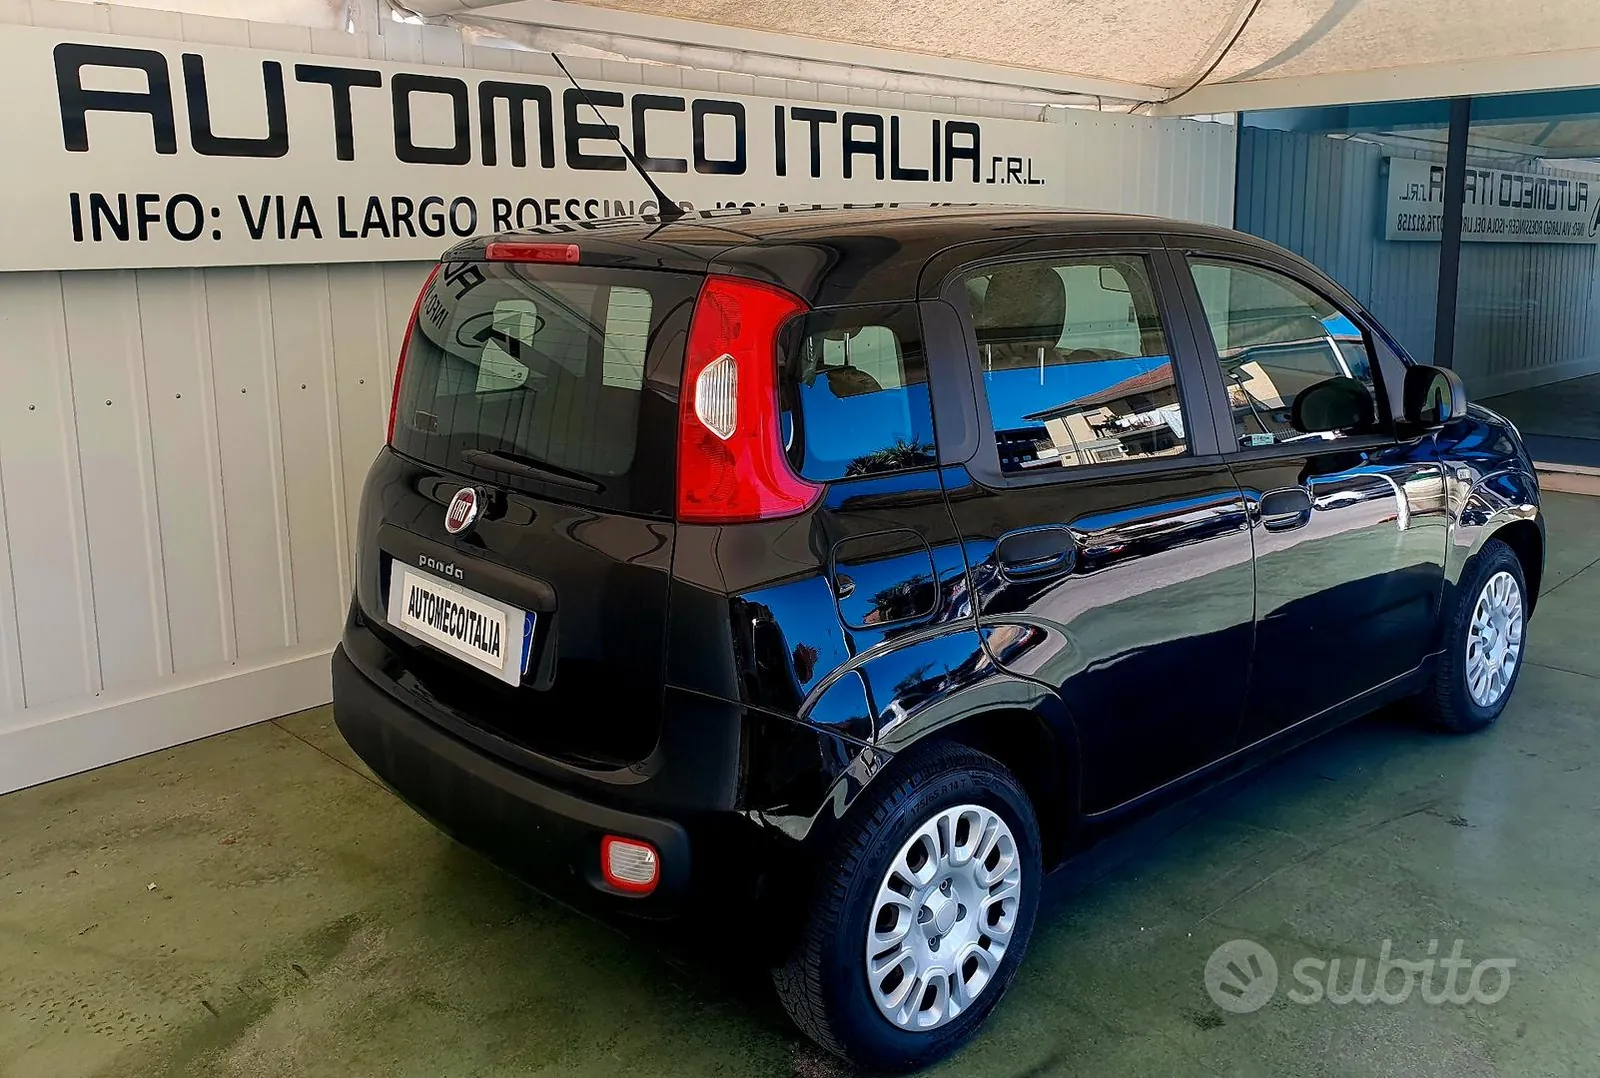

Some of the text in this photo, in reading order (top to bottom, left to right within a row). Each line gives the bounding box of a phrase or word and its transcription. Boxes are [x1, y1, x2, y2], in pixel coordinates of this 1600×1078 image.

[54, 43, 1045, 185] AUTOMECO ITALIA S.R.L.
[69, 193, 694, 242] INFO: VIA LARGO ROESS
[449, 498, 472, 523] FIAT
[418, 552, 465, 580] panda
[407, 584, 500, 658] AUTOMECOITALIA
